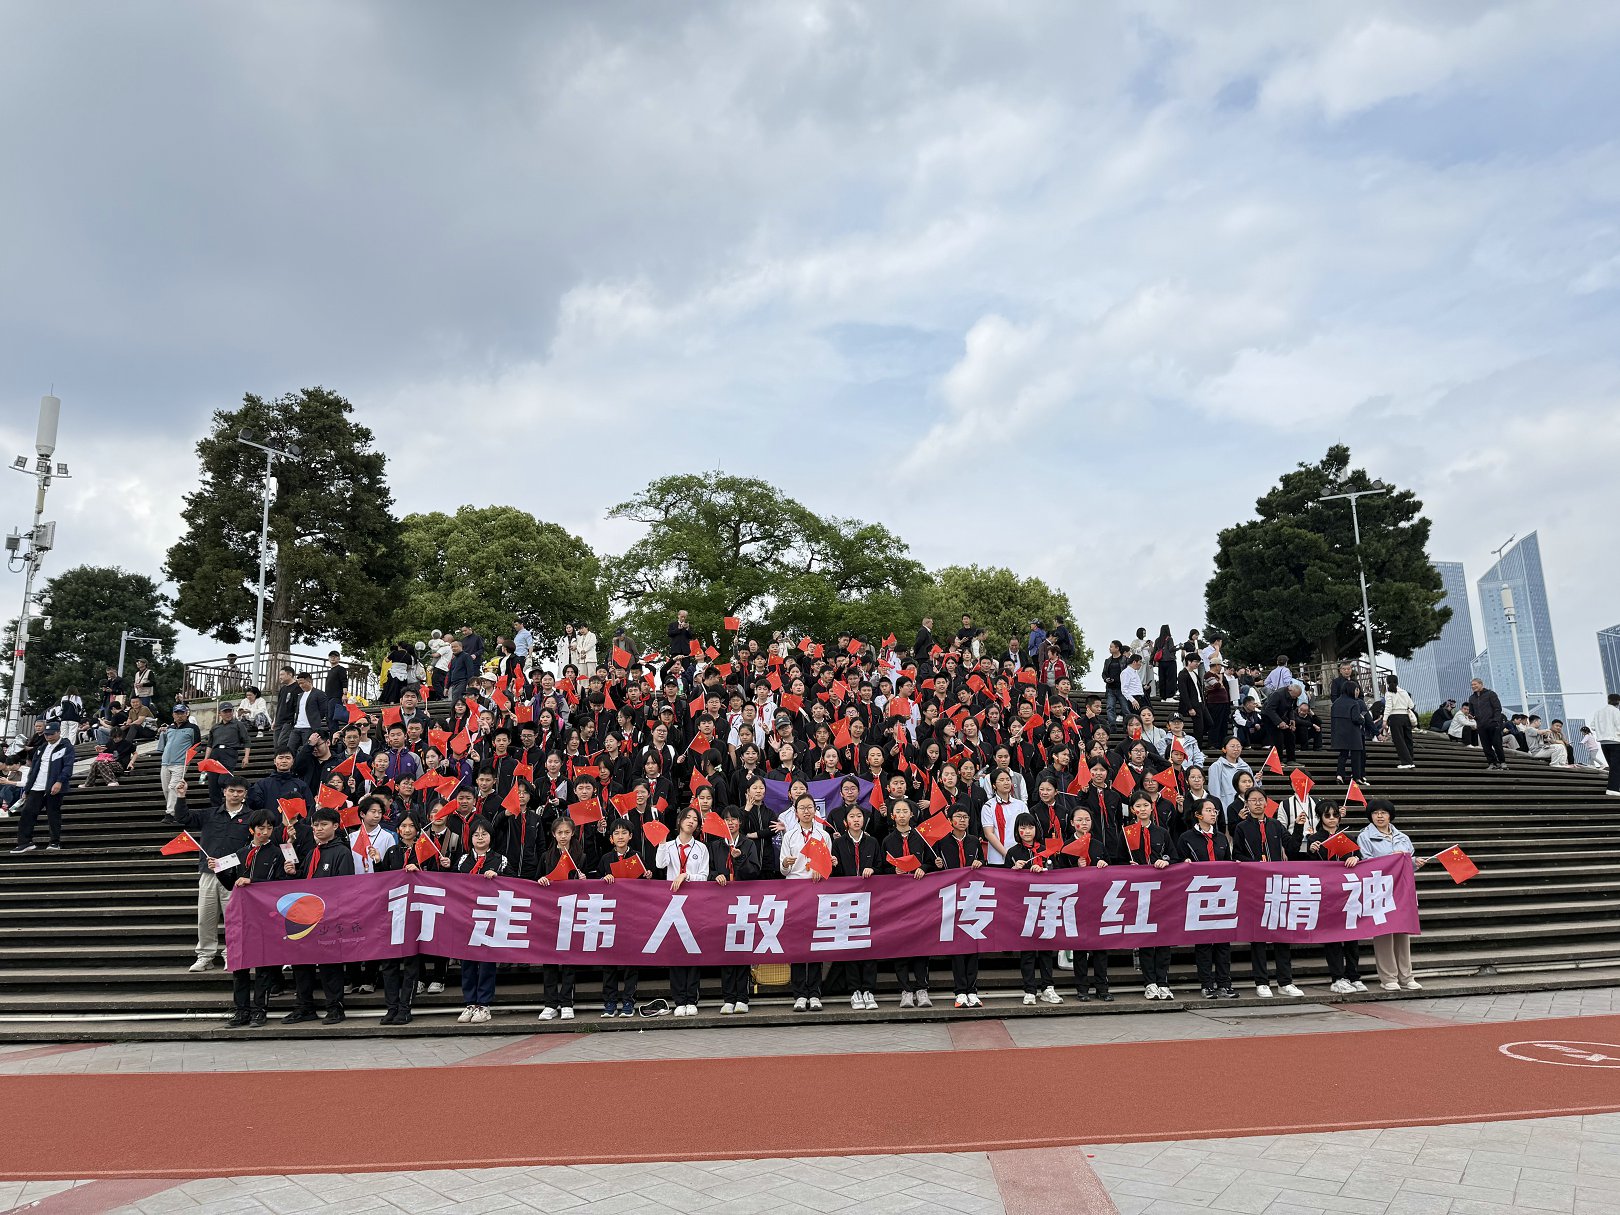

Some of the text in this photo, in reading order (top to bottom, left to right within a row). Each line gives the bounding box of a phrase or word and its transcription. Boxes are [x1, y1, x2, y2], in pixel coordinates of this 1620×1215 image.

[387, 869, 1397, 954] 行走伟人故里 传承红色精神
